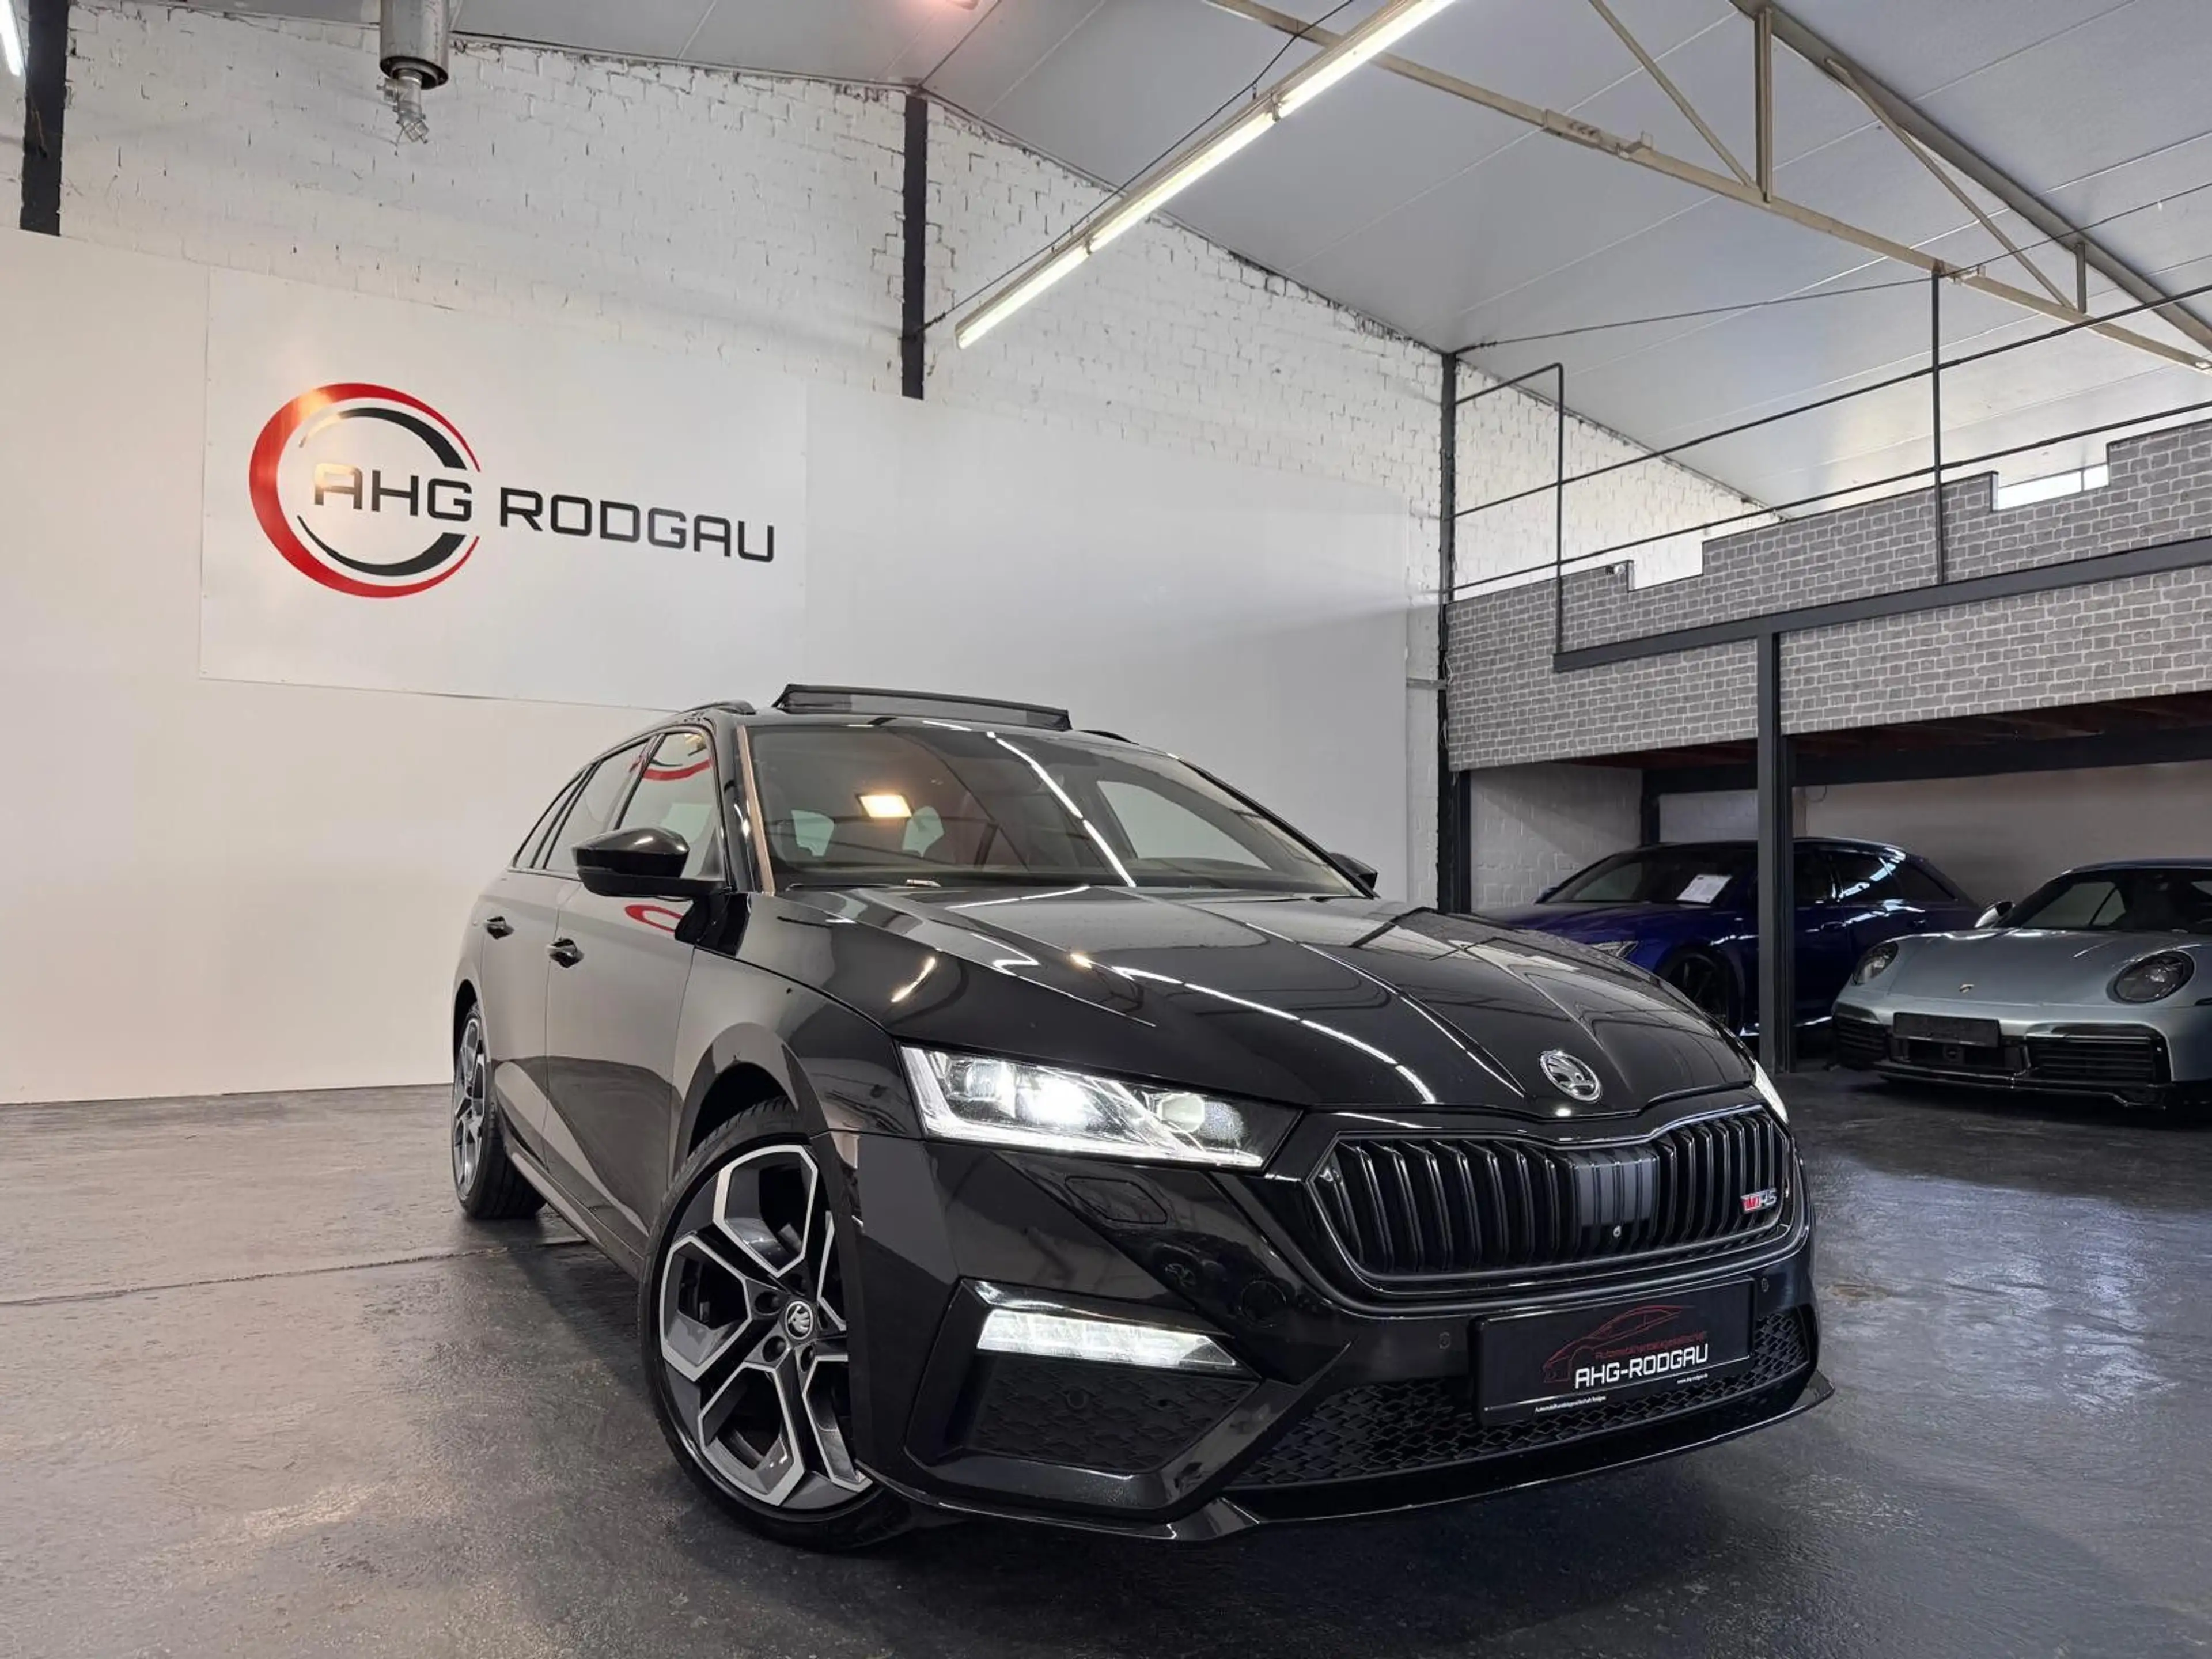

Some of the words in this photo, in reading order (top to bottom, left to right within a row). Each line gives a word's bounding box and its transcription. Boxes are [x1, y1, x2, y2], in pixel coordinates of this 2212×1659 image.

[314, 463, 473, 522] AHG
[499, 487, 775, 563] RODGAU
[1574, 1343, 1709, 1389] AHG-RODGAU
